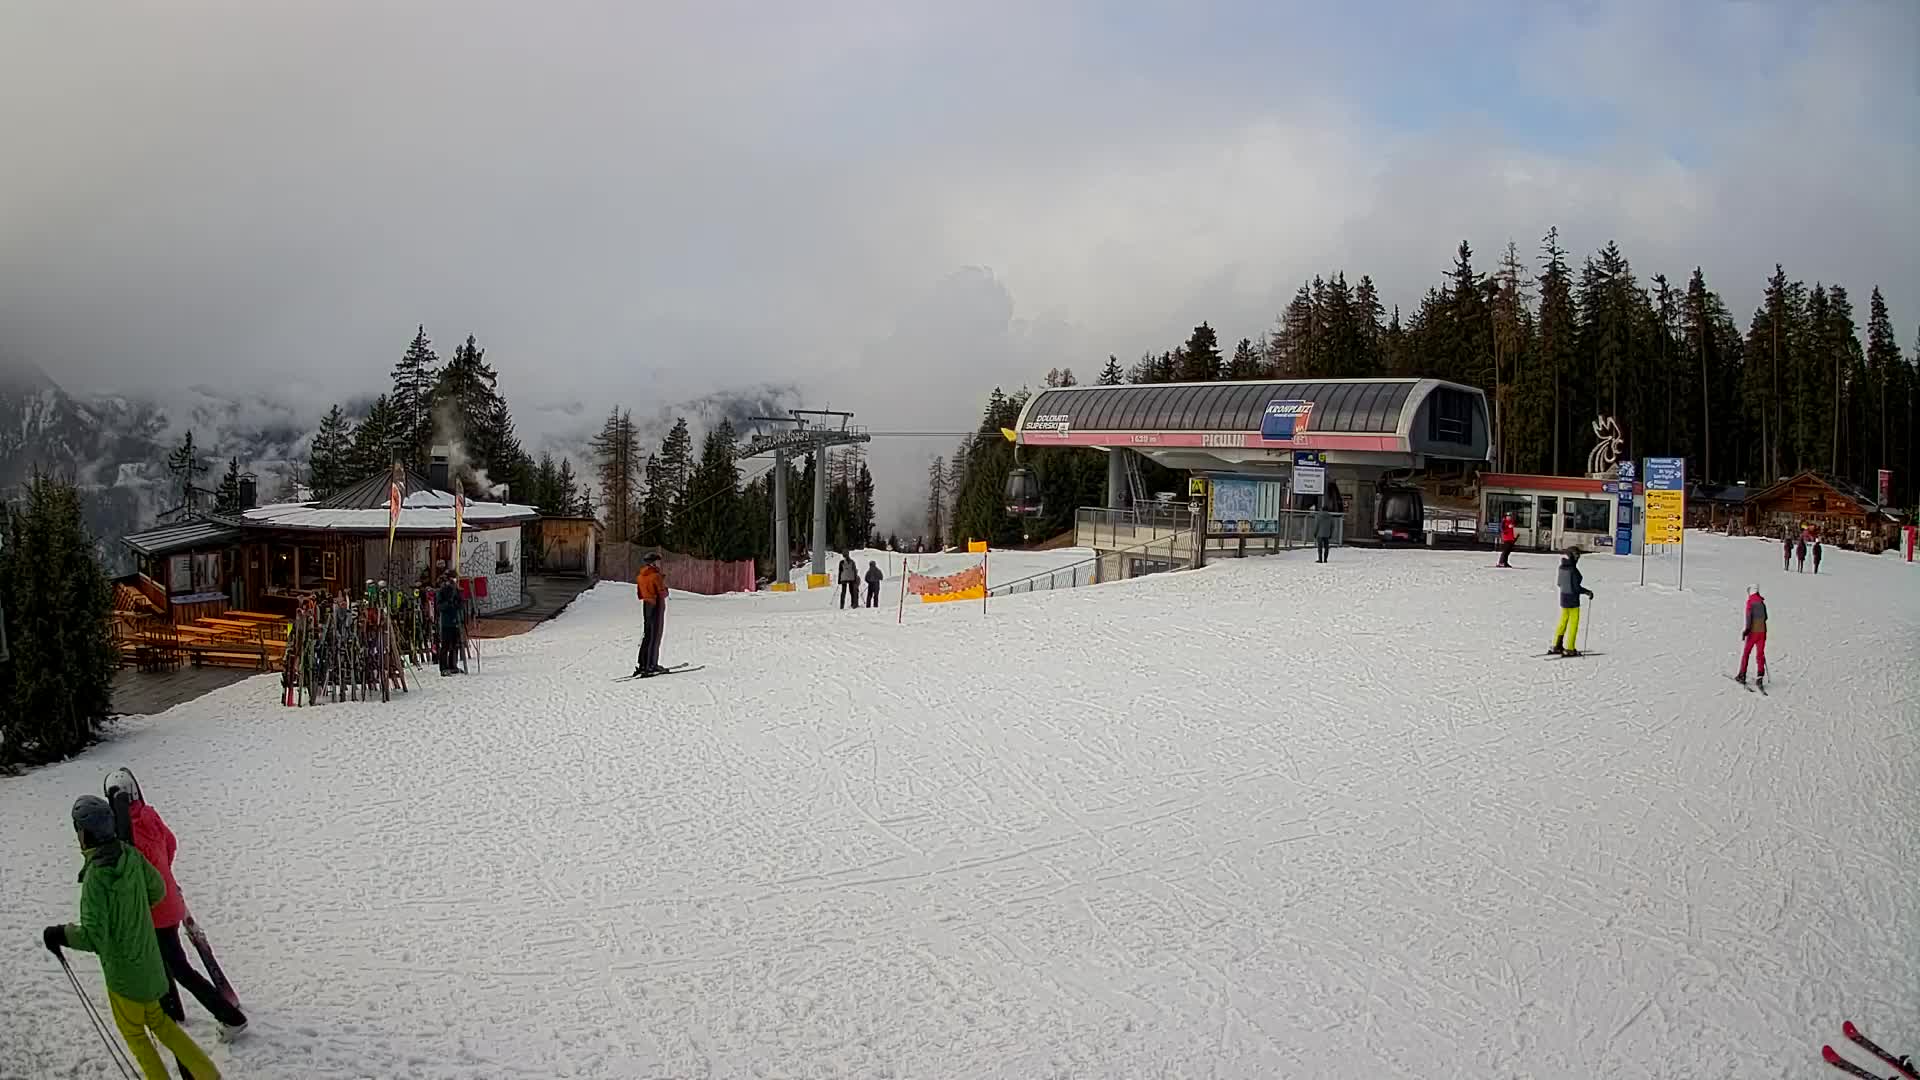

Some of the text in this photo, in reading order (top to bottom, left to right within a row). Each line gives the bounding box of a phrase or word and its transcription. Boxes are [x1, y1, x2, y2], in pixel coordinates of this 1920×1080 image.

[1266, 405, 1311, 413] KRONPLATZ
[1026, 422, 1059, 430] SUPERSKI
[1202, 434, 1245, 447] PICULIN
